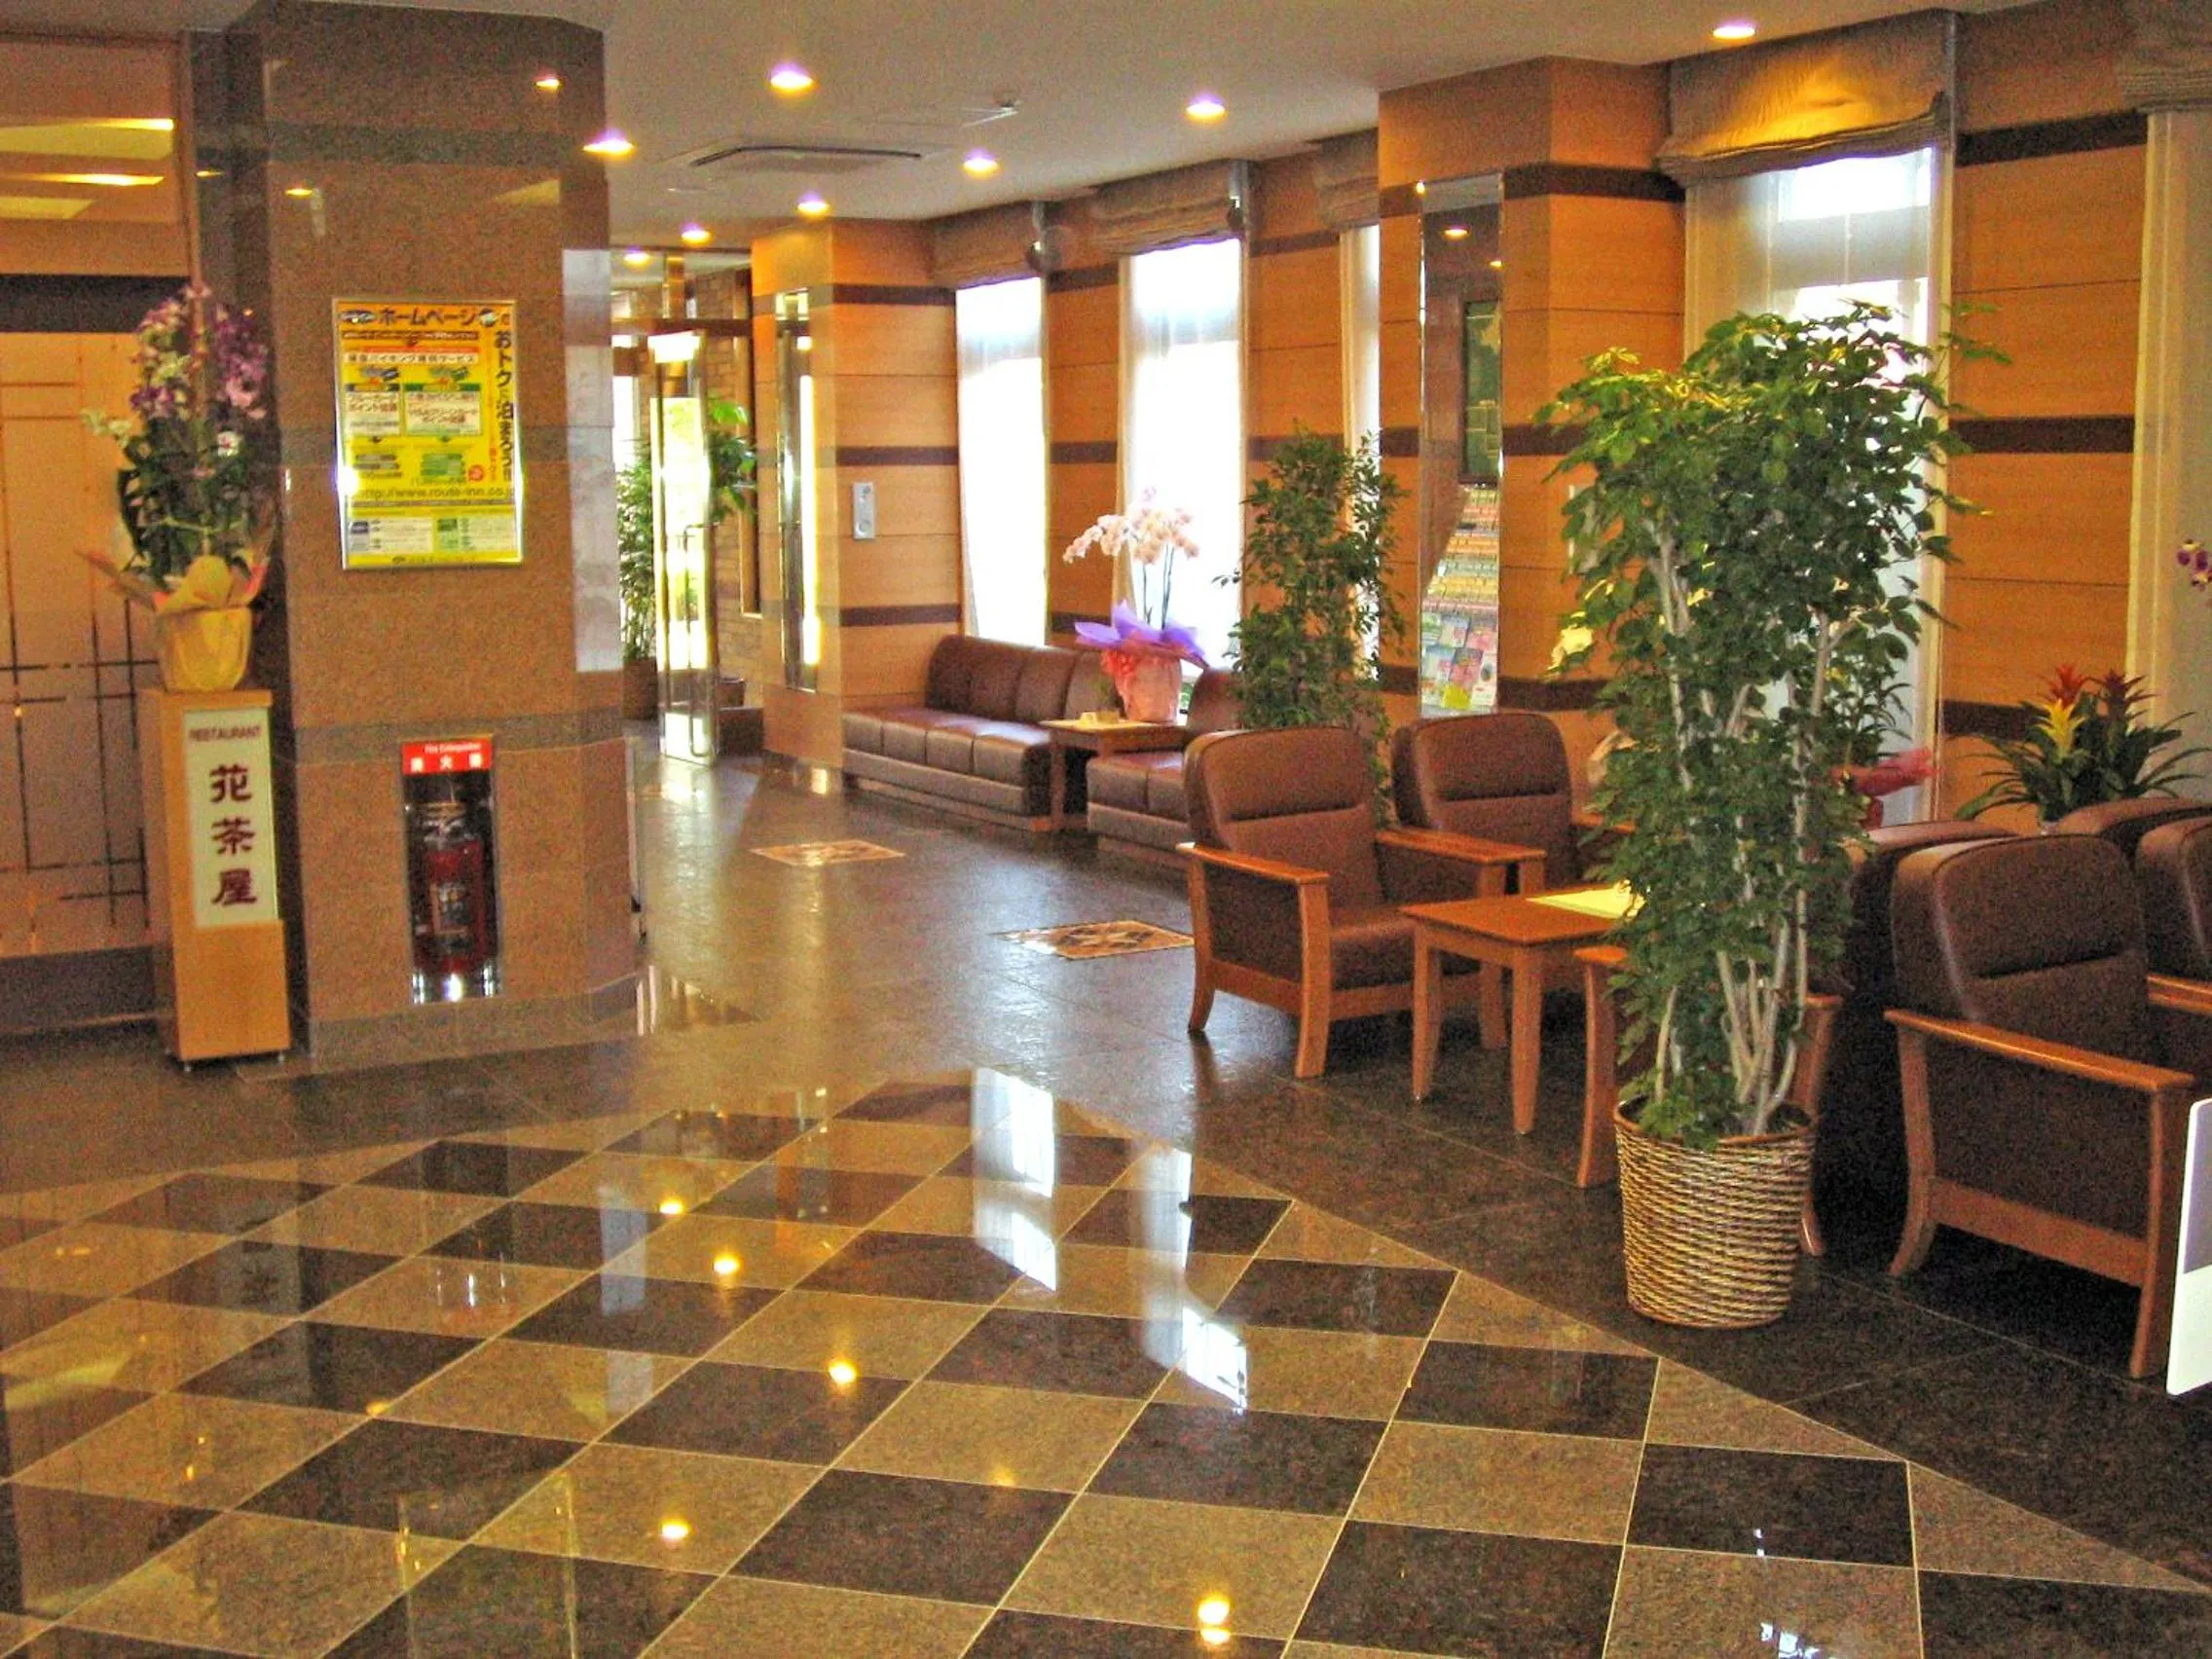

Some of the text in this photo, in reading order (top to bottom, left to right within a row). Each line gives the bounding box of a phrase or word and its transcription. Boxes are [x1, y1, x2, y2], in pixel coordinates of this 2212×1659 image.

[380, 307, 476, 326] ホームページ
[209, 763, 257, 905] 花茶屋
